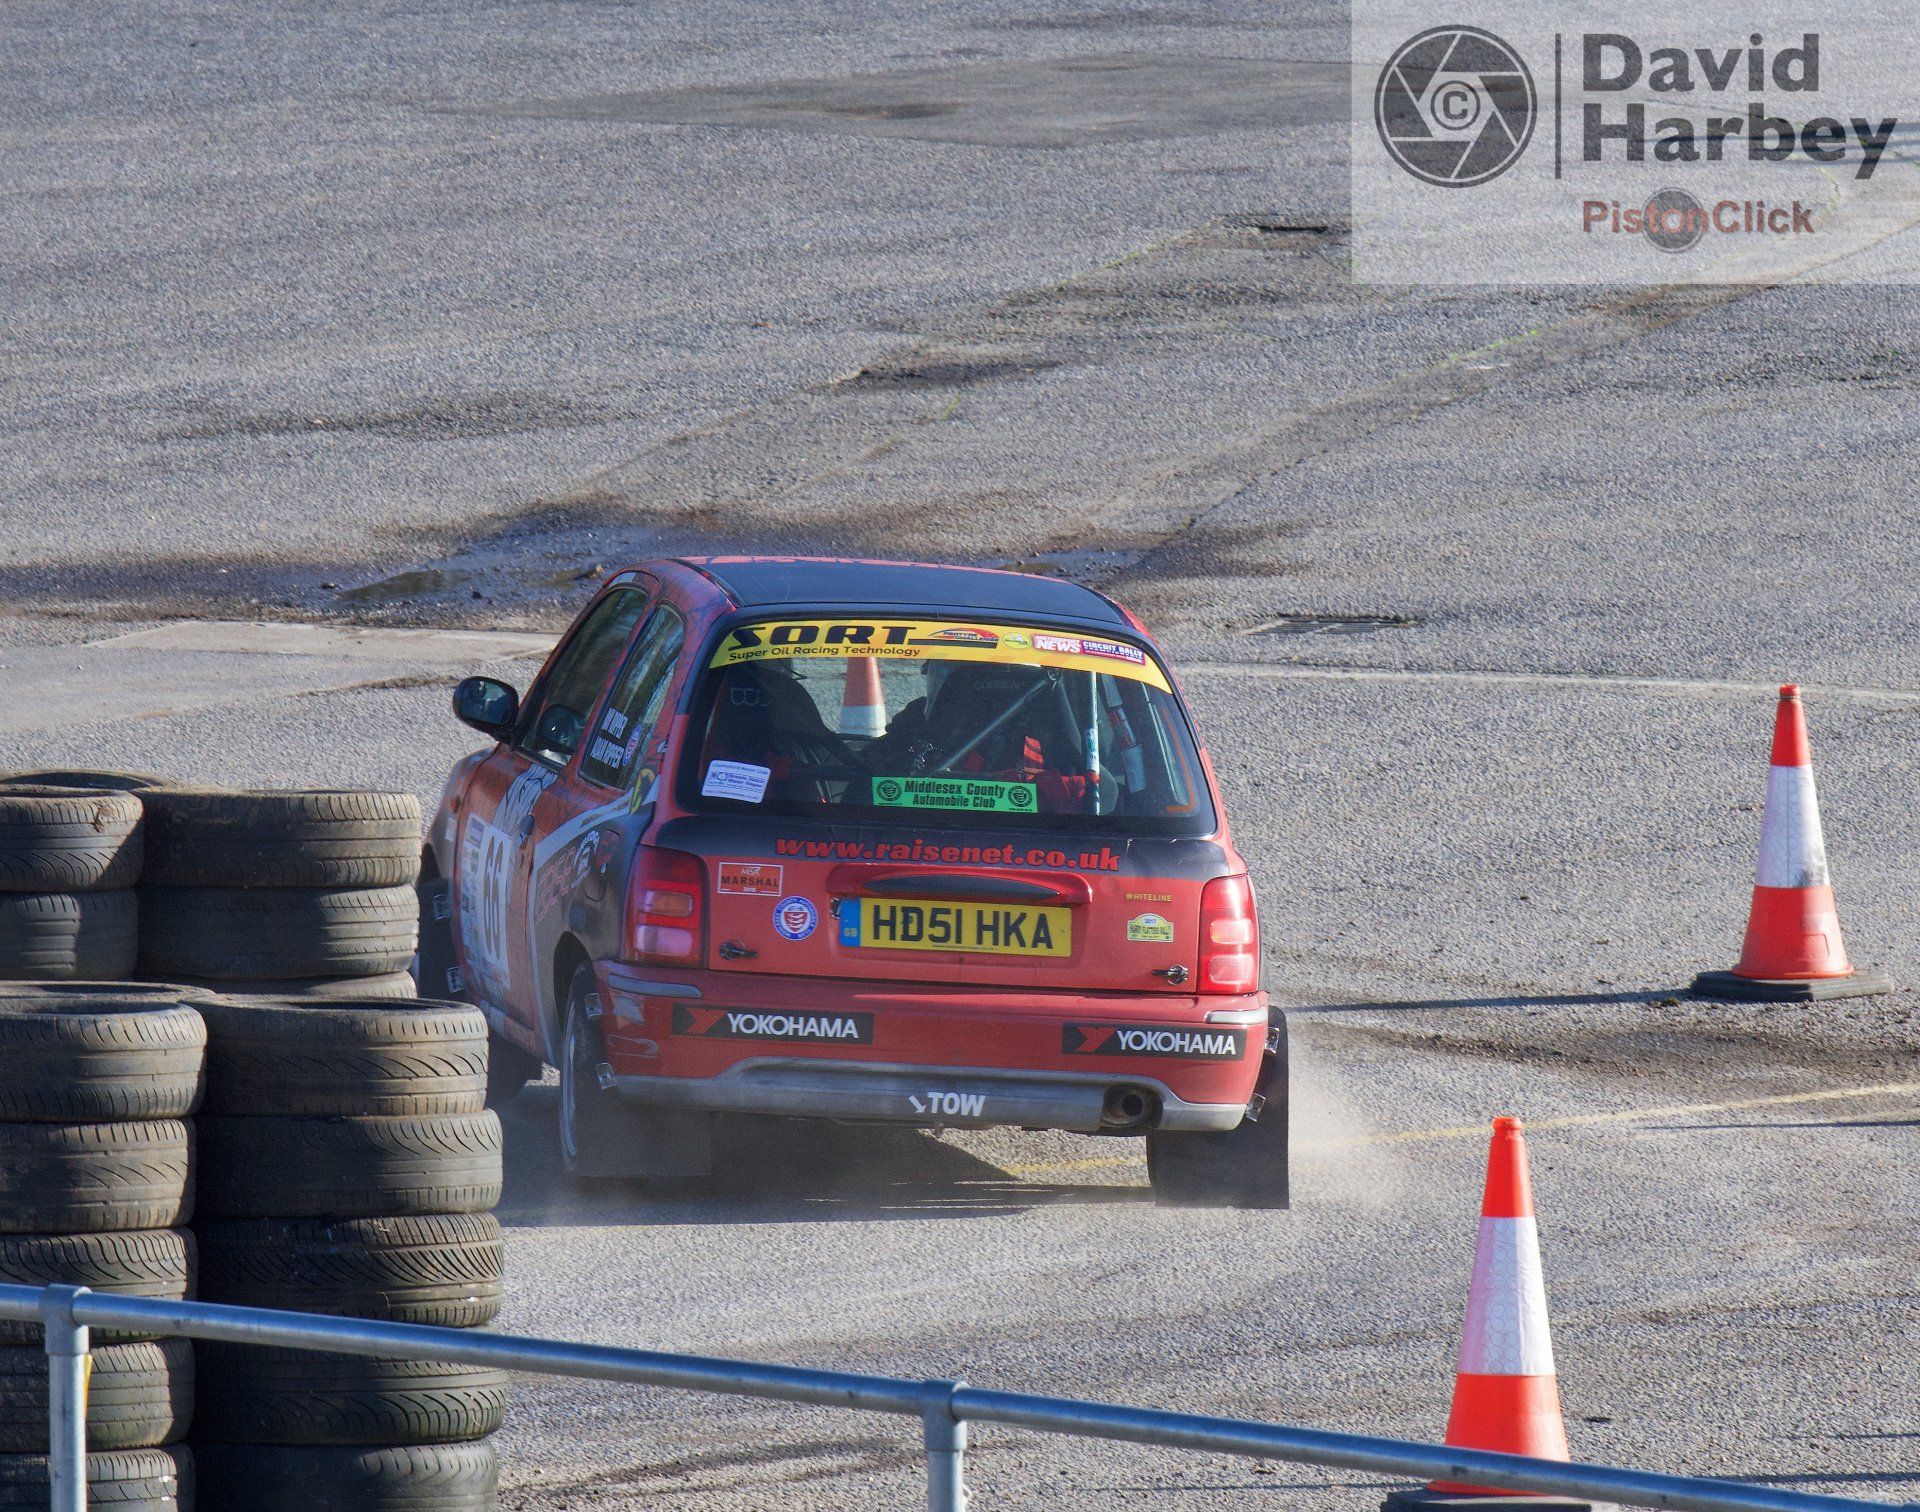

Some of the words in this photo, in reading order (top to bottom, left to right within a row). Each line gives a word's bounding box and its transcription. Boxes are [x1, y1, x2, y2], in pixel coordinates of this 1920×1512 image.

[728, 626, 917, 651] SORT
[1036, 639, 1081, 653] NEWS
[729, 650, 768, 661] Super
[771, 646, 790, 656] Oil
[793, 646, 839, 656] Racing
[844, 645, 921, 657] Technology
[1083, 641, 1117, 652] CIRCUIT
[1118, 645, 1143, 657] RALLY
[904, 781, 962, 795] Middlesex
[966, 783, 1006, 799] County
[912, 794, 969, 807] Automobile
[973, 796, 996, 808] Club
[775, 838, 1120, 871] www.raisenet.co.uk
[721, 876, 779, 888] MARSHAL
[1125, 893, 1173, 902] WHITELINE
[842, 927, 859, 938] GB
[872, 904, 963, 944] HD51
[976, 909, 1054, 950] HKA
[726, 1013, 860, 1039] YOKOHAMA
[1116, 1030, 1236, 1055] YOKOHAMA
[927, 1091, 986, 1117] TOW
